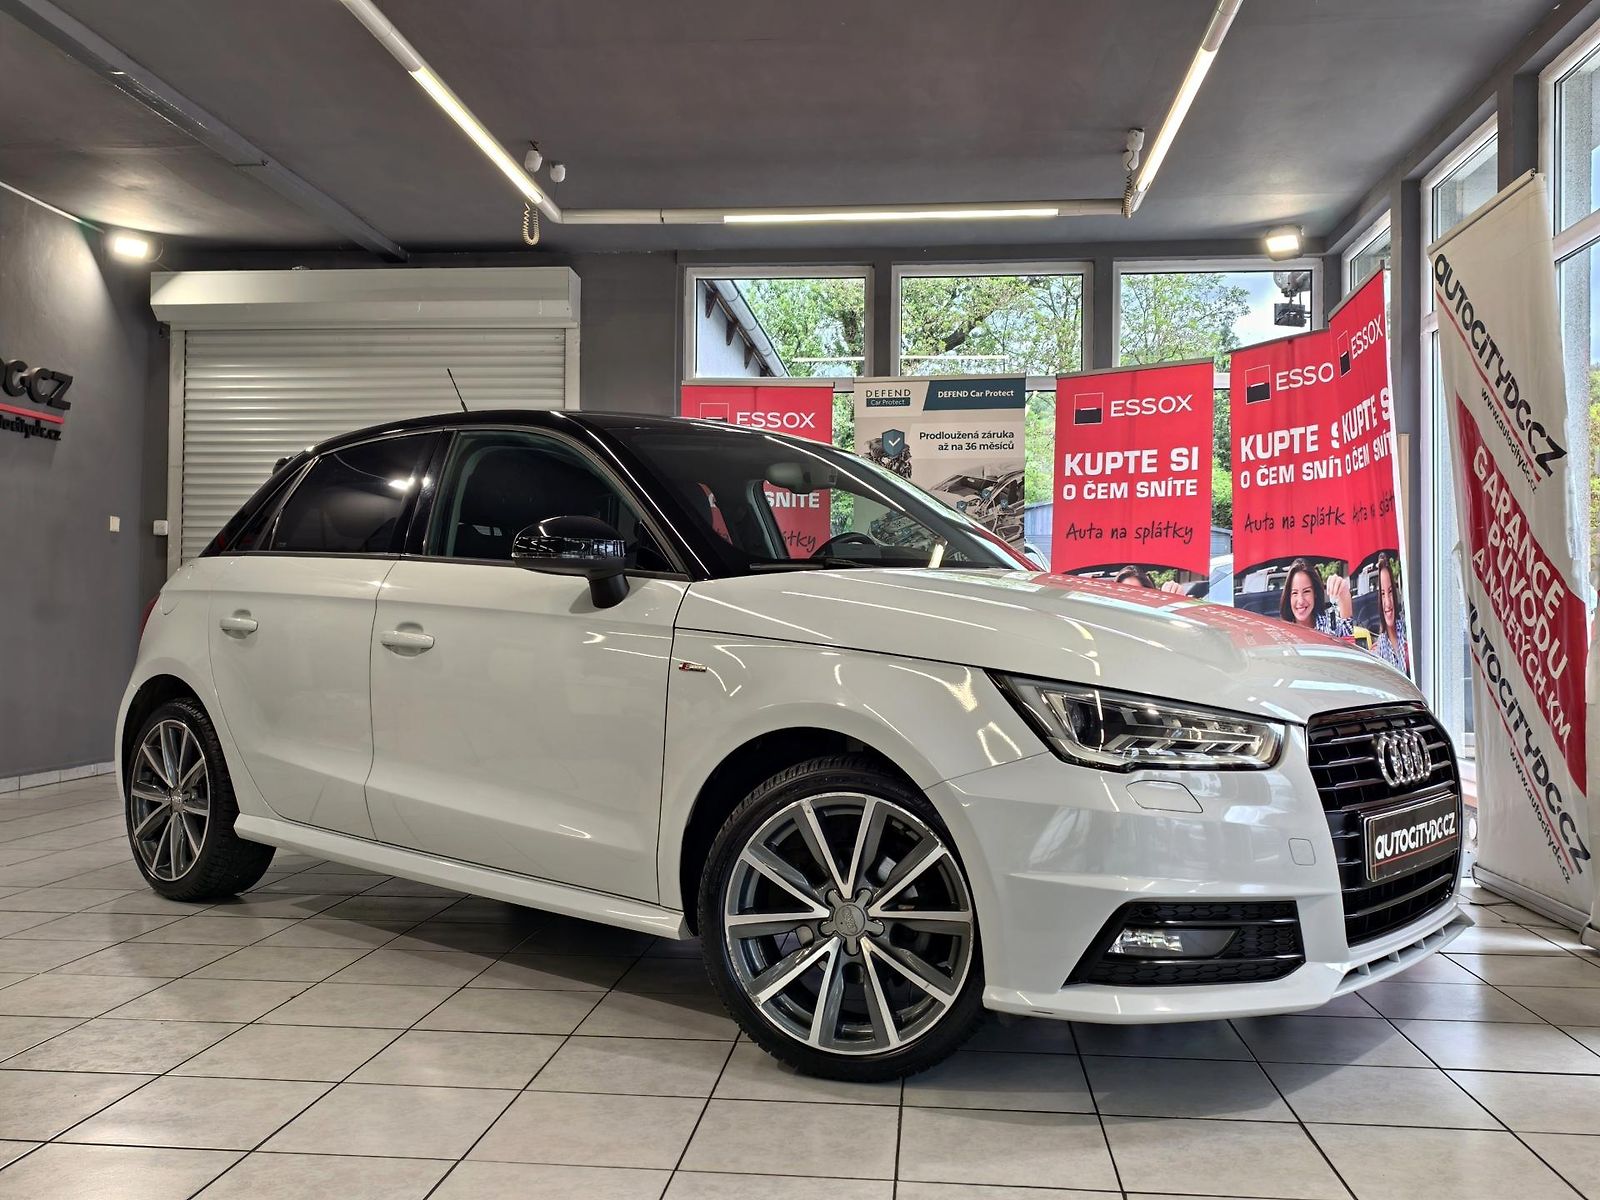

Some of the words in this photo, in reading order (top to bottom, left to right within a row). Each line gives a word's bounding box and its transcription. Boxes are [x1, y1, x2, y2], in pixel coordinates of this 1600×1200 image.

[1350, 314, 1383, 360] ESSOX
[1276, 362, 1334, 391] ESSO
[866, 388, 911, 398] DEFEND
[871, 398, 880, 406] Car
[882, 397, 905, 406] Protect
[937, 390, 968, 398] DEFEND
[985, 389, 1014, 397] Protect
[1110, 394, 1193, 417] ESSOX
[736, 411, 815, 429] ESSOX
[1341, 394, 1378, 445] KUPTE
[1380, 387, 1391, 421] S
[919, 430, 979, 440] Prodloužená
[981, 429, 1014, 439] záruka
[938, 441, 950, 451] až
[951, 443, 964, 451] na
[965, 442, 977, 450] 36
[979, 440, 1014, 450] měsíců
[1240, 424, 1319, 463] KUPTE
[1331, 421, 1340, 449] S
[1064, 449, 1158, 477] KUPTE
[1170, 446, 1199, 472] SI
[1345, 453, 1352, 475] O
[1352, 445, 1371, 472] ČEM
[1373, 429, 1393, 461] SNÍT
[1240, 471, 1250, 489] O
[1256, 462, 1295, 487] ČEM
[1302, 455, 1342, 481] SNÍT
[1062, 484, 1077, 500] O
[1083, 480, 1128, 500] ČEM
[1136, 477, 1198, 498] SNÍTE
[1066, 522, 1103, 540] Auta
[1110, 527, 1127, 540] na
[1134, 521, 1193, 545] splátky
[1244, 512, 1275, 534] Auta
[1282, 513, 1295, 529] na
[1302, 506, 1346, 535] splátk
[1473, 445, 1564, 619] GARANCE
[1488, 520, 1568, 680] PŮVODU
[1473, 548, 1485, 571] A
[1485, 570, 1547, 695] NAJETÝCH
[1547, 690, 1572, 744] KM
